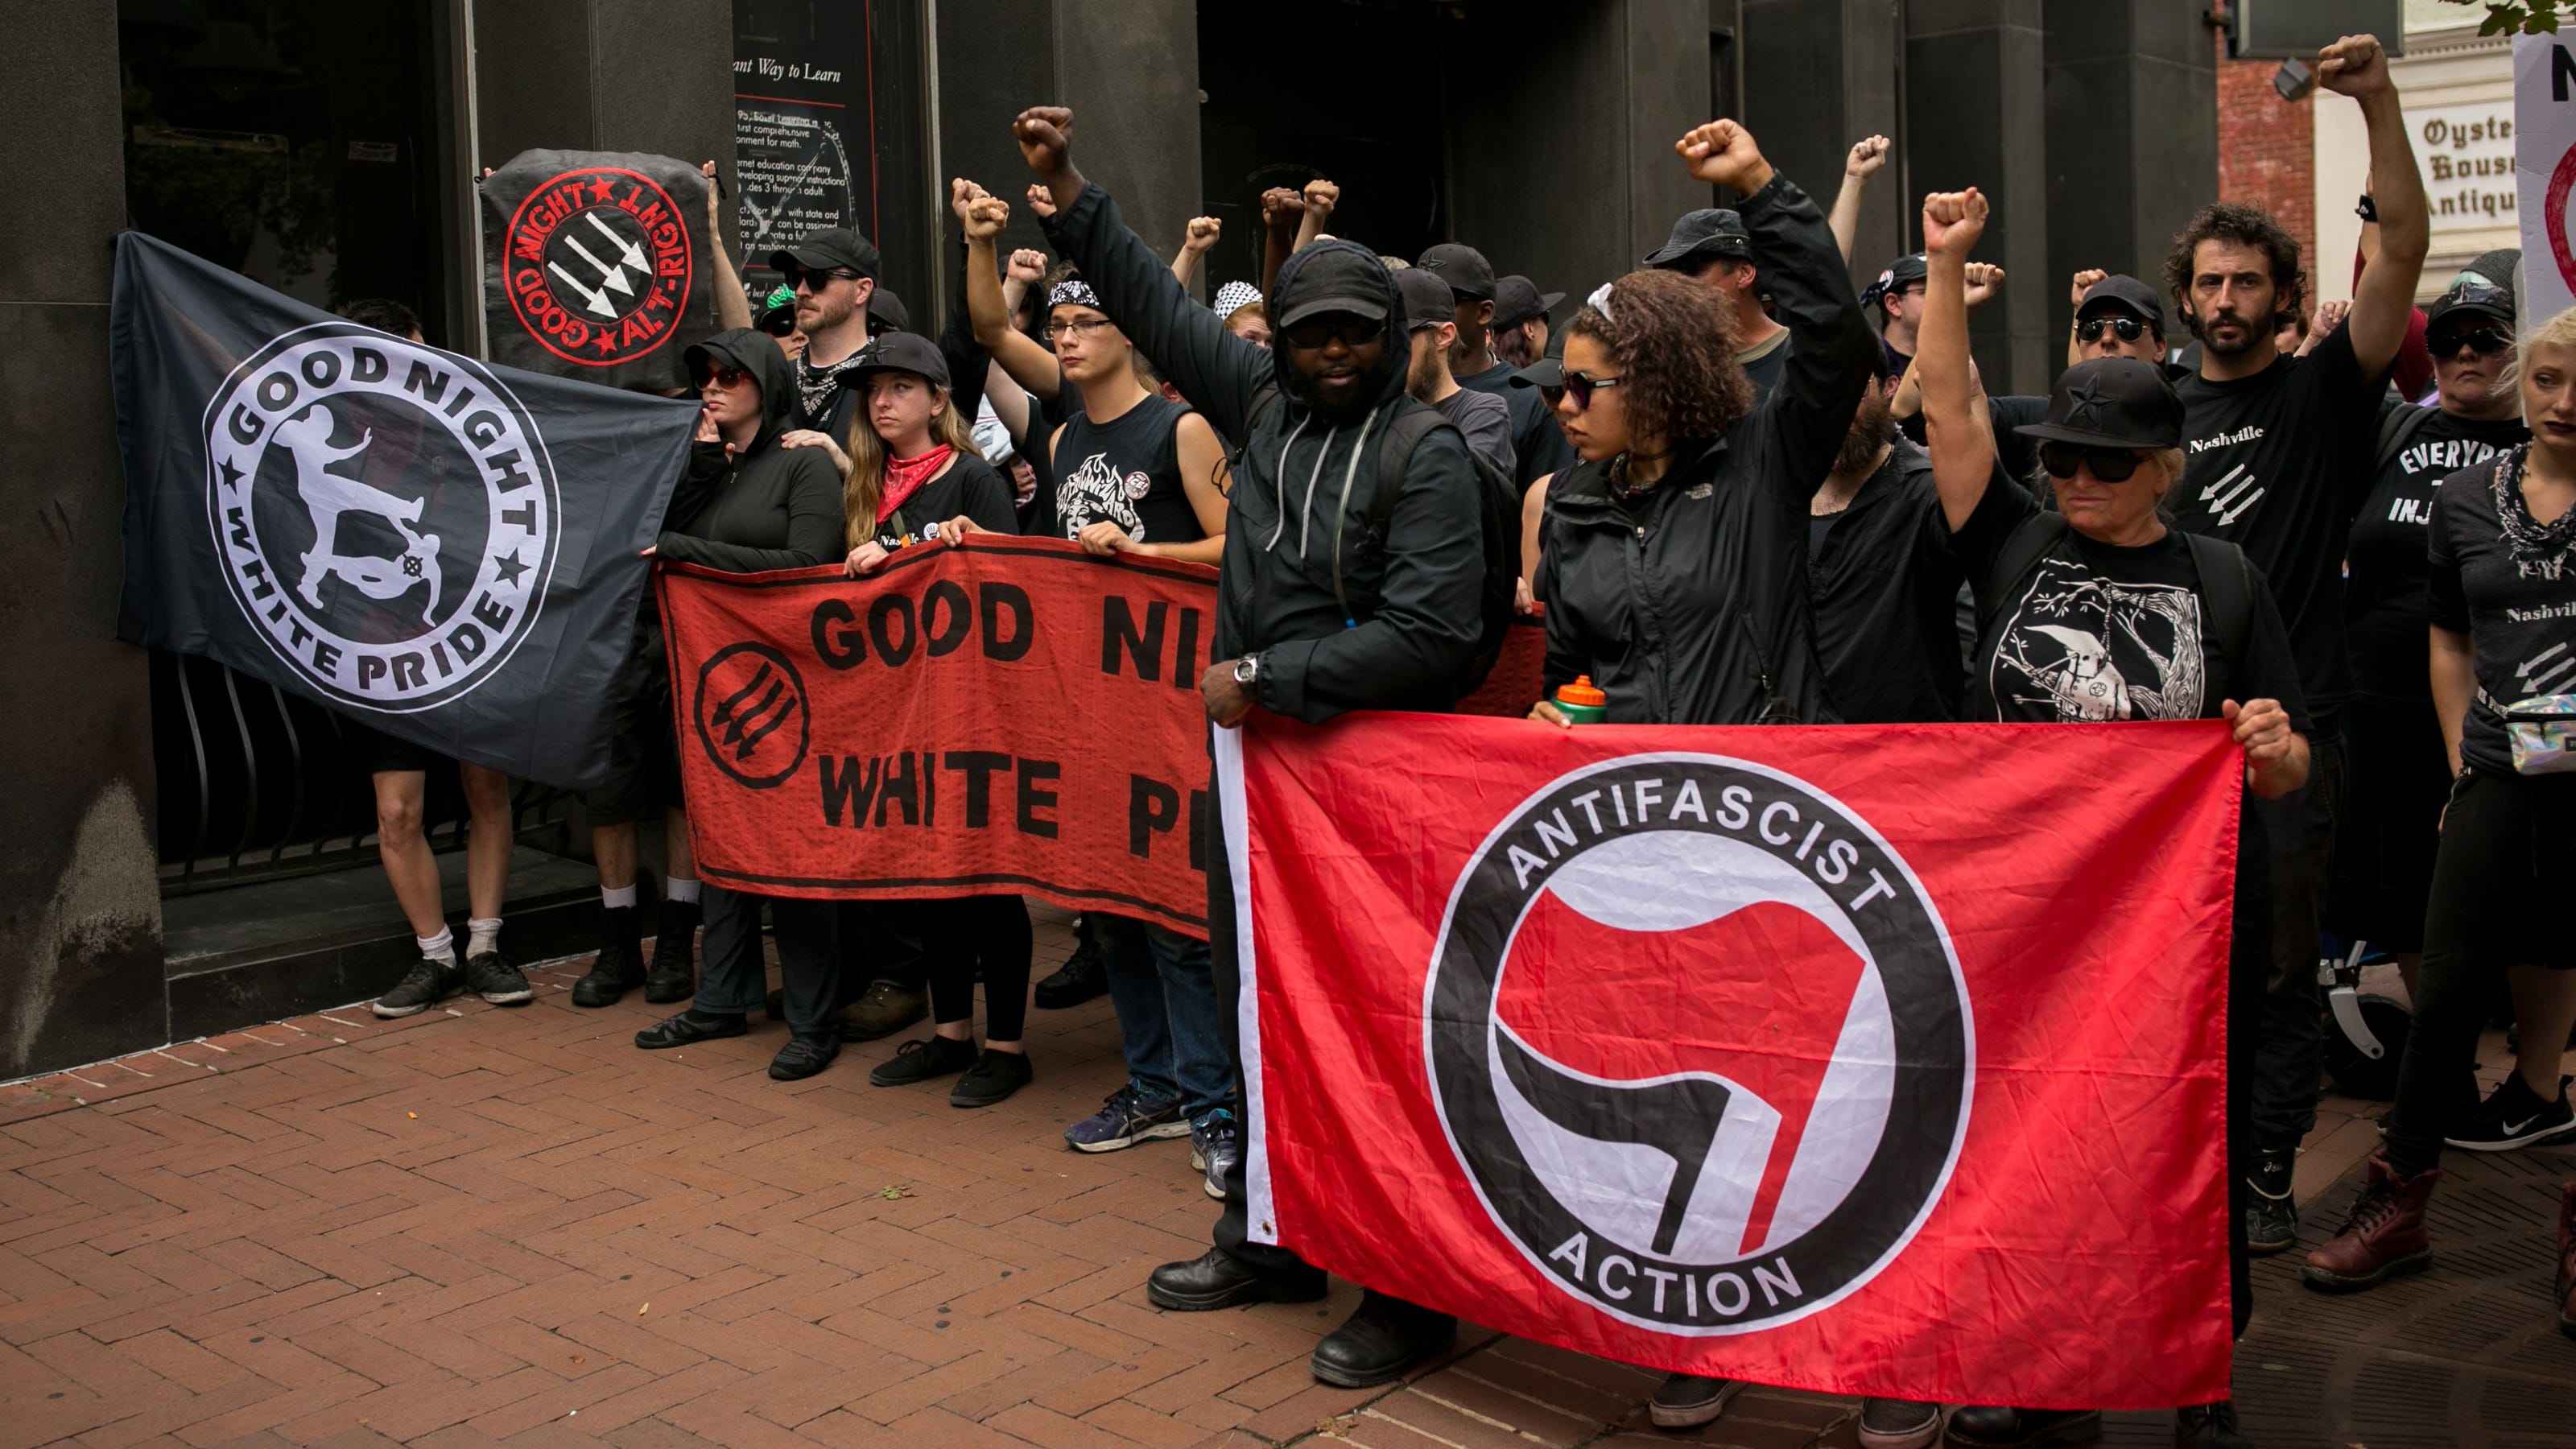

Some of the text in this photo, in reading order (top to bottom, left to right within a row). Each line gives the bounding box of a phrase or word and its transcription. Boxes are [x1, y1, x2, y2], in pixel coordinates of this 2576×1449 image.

[758, 57, 784, 81] Way
[789, 64, 799, 78] to
[803, 63, 841, 83] Learn
[753, 126, 810, 138] comprehensive
[767, 136, 778, 146] for
[780, 138, 802, 148] math.
[757, 159, 795, 171] education
[765, 183, 770, 192] 3
[803, 186, 825, 196] adult.
[807, 176, 845, 186] instructiona
[514, 181, 585, 261] NIGHT
[778, 221, 791, 229] can
[794, 219, 803, 229] be
[788, 207, 803, 217] with
[806, 208, 823, 218] state
[824, 209, 839, 220] and
[515, 268, 589, 349] GOOD
[229, 347, 537, 536] GOOD NIGHT
[2190, 425, 2264, 453] Nashville
[226, 506, 514, 691] WHITE PRIDE
[811, 580, 1034, 671] GOOD
[818, 750, 1061, 840] WHITE
[1506, 778, 1897, 913] ANTIFASCIST
[1549, 1231, 1803, 1318] ACTION
